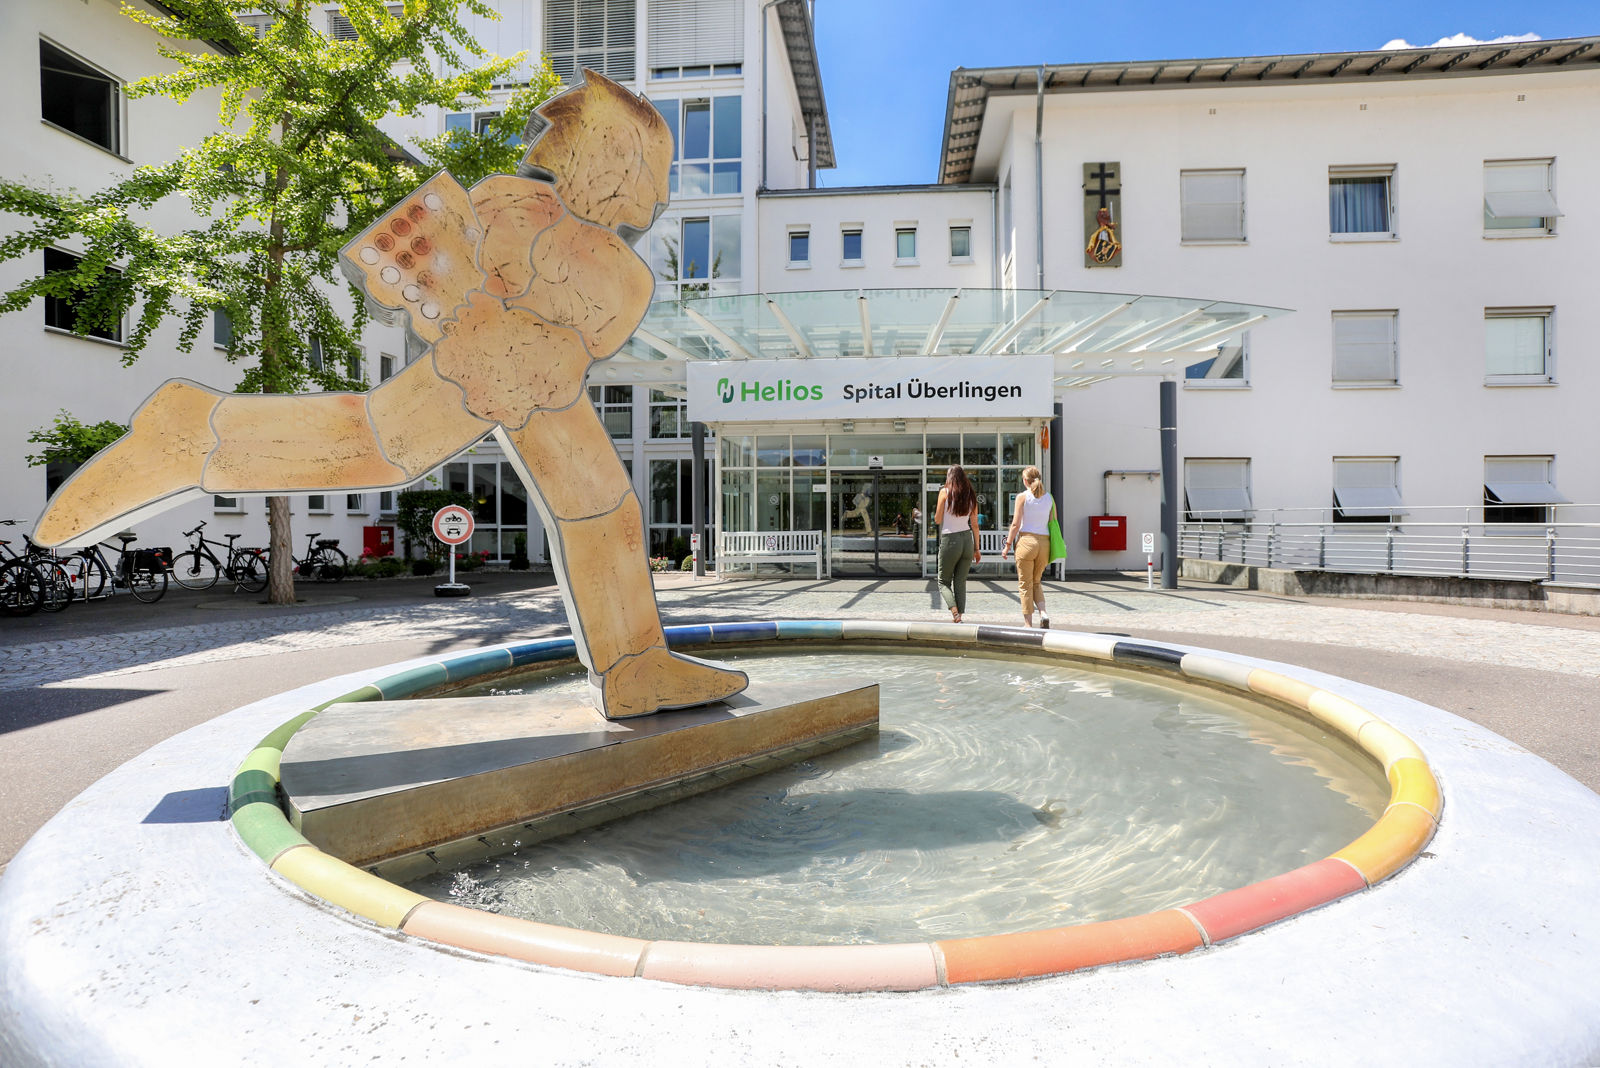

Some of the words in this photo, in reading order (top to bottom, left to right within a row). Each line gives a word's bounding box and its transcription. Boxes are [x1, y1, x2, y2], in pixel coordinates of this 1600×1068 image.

[740, 379, 824, 402] Helios
[843, 382, 902, 403] Spital
[907, 378, 1022, 402] Überlingen
